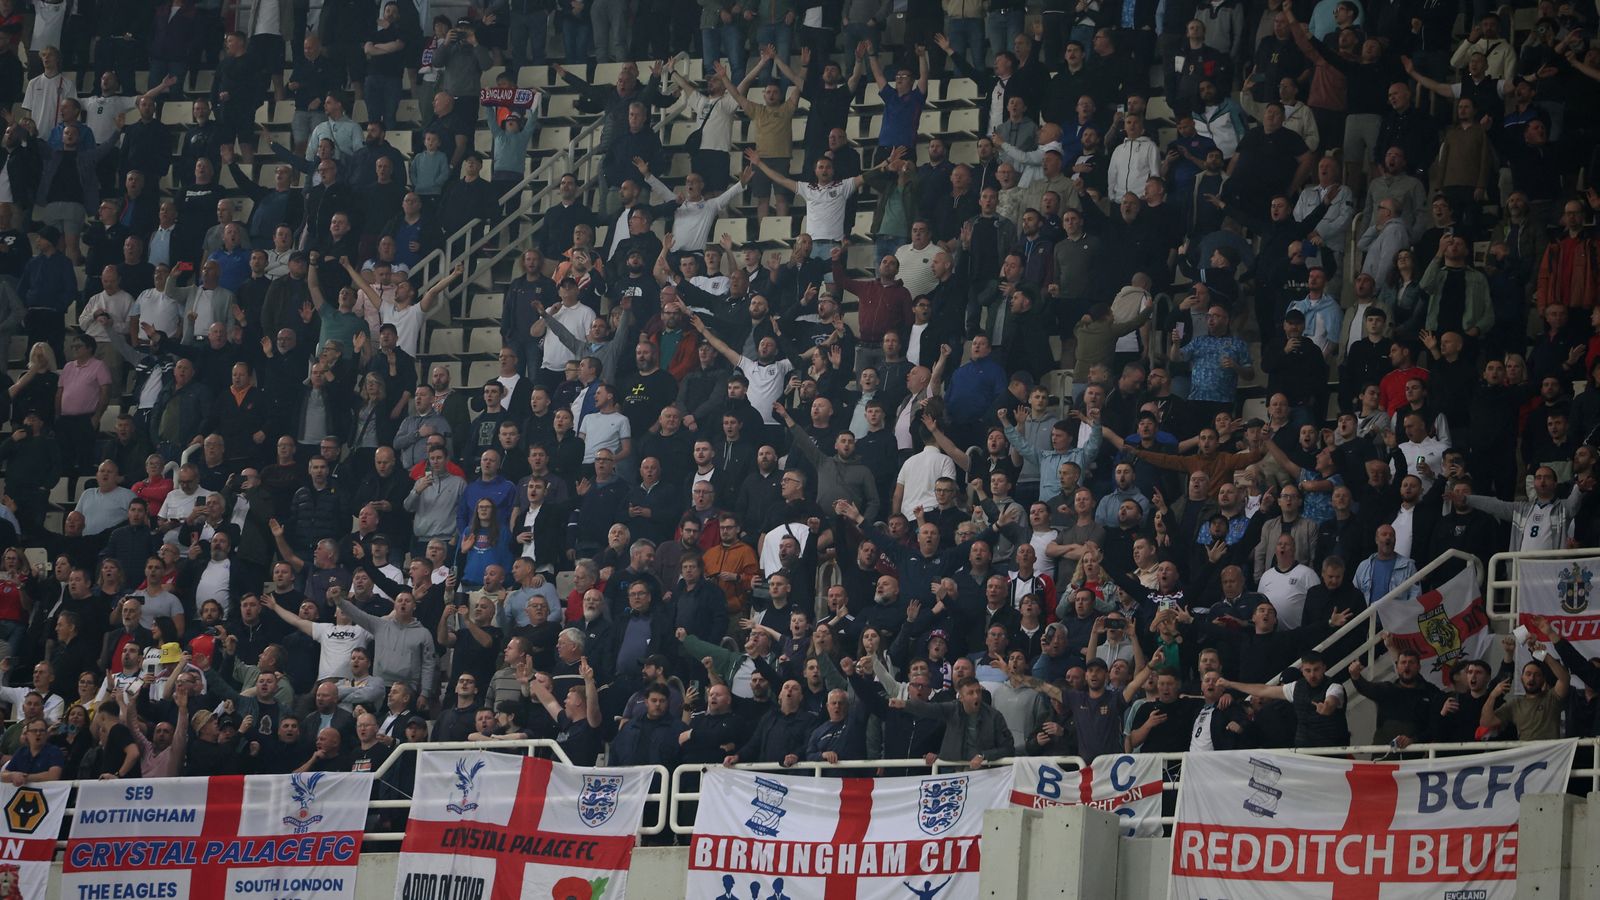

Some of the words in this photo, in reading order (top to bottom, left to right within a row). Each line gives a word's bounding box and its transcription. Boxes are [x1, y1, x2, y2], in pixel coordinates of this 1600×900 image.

[486, 88, 513, 100] ENGLAND
[1530, 525, 1539, 538] 8
[1036, 764, 1063, 799] B
[1110, 755, 1137, 792] C
[125, 785, 154, 801] SE9
[80, 808, 196, 824] MOTTINGHAM
[0, 839, 25, 860] N
[71, 839, 198, 869] CRYSTAL
[201, 836, 317, 865] PALACE
[316, 835, 356, 862] FC
[509, 834, 576, 859] PALACE
[576, 840, 599, 862] FC
[694, 836, 907, 875] BIRMINGHAM
[919, 838, 982, 872] CIT
[1179, 829, 1395, 875] REDDITCH
[78, 883, 110, 900] THE
[113, 882, 178, 899] EAGLES
[234, 878, 280, 893] SOUTH
[283, 878, 343, 892] LONDON
